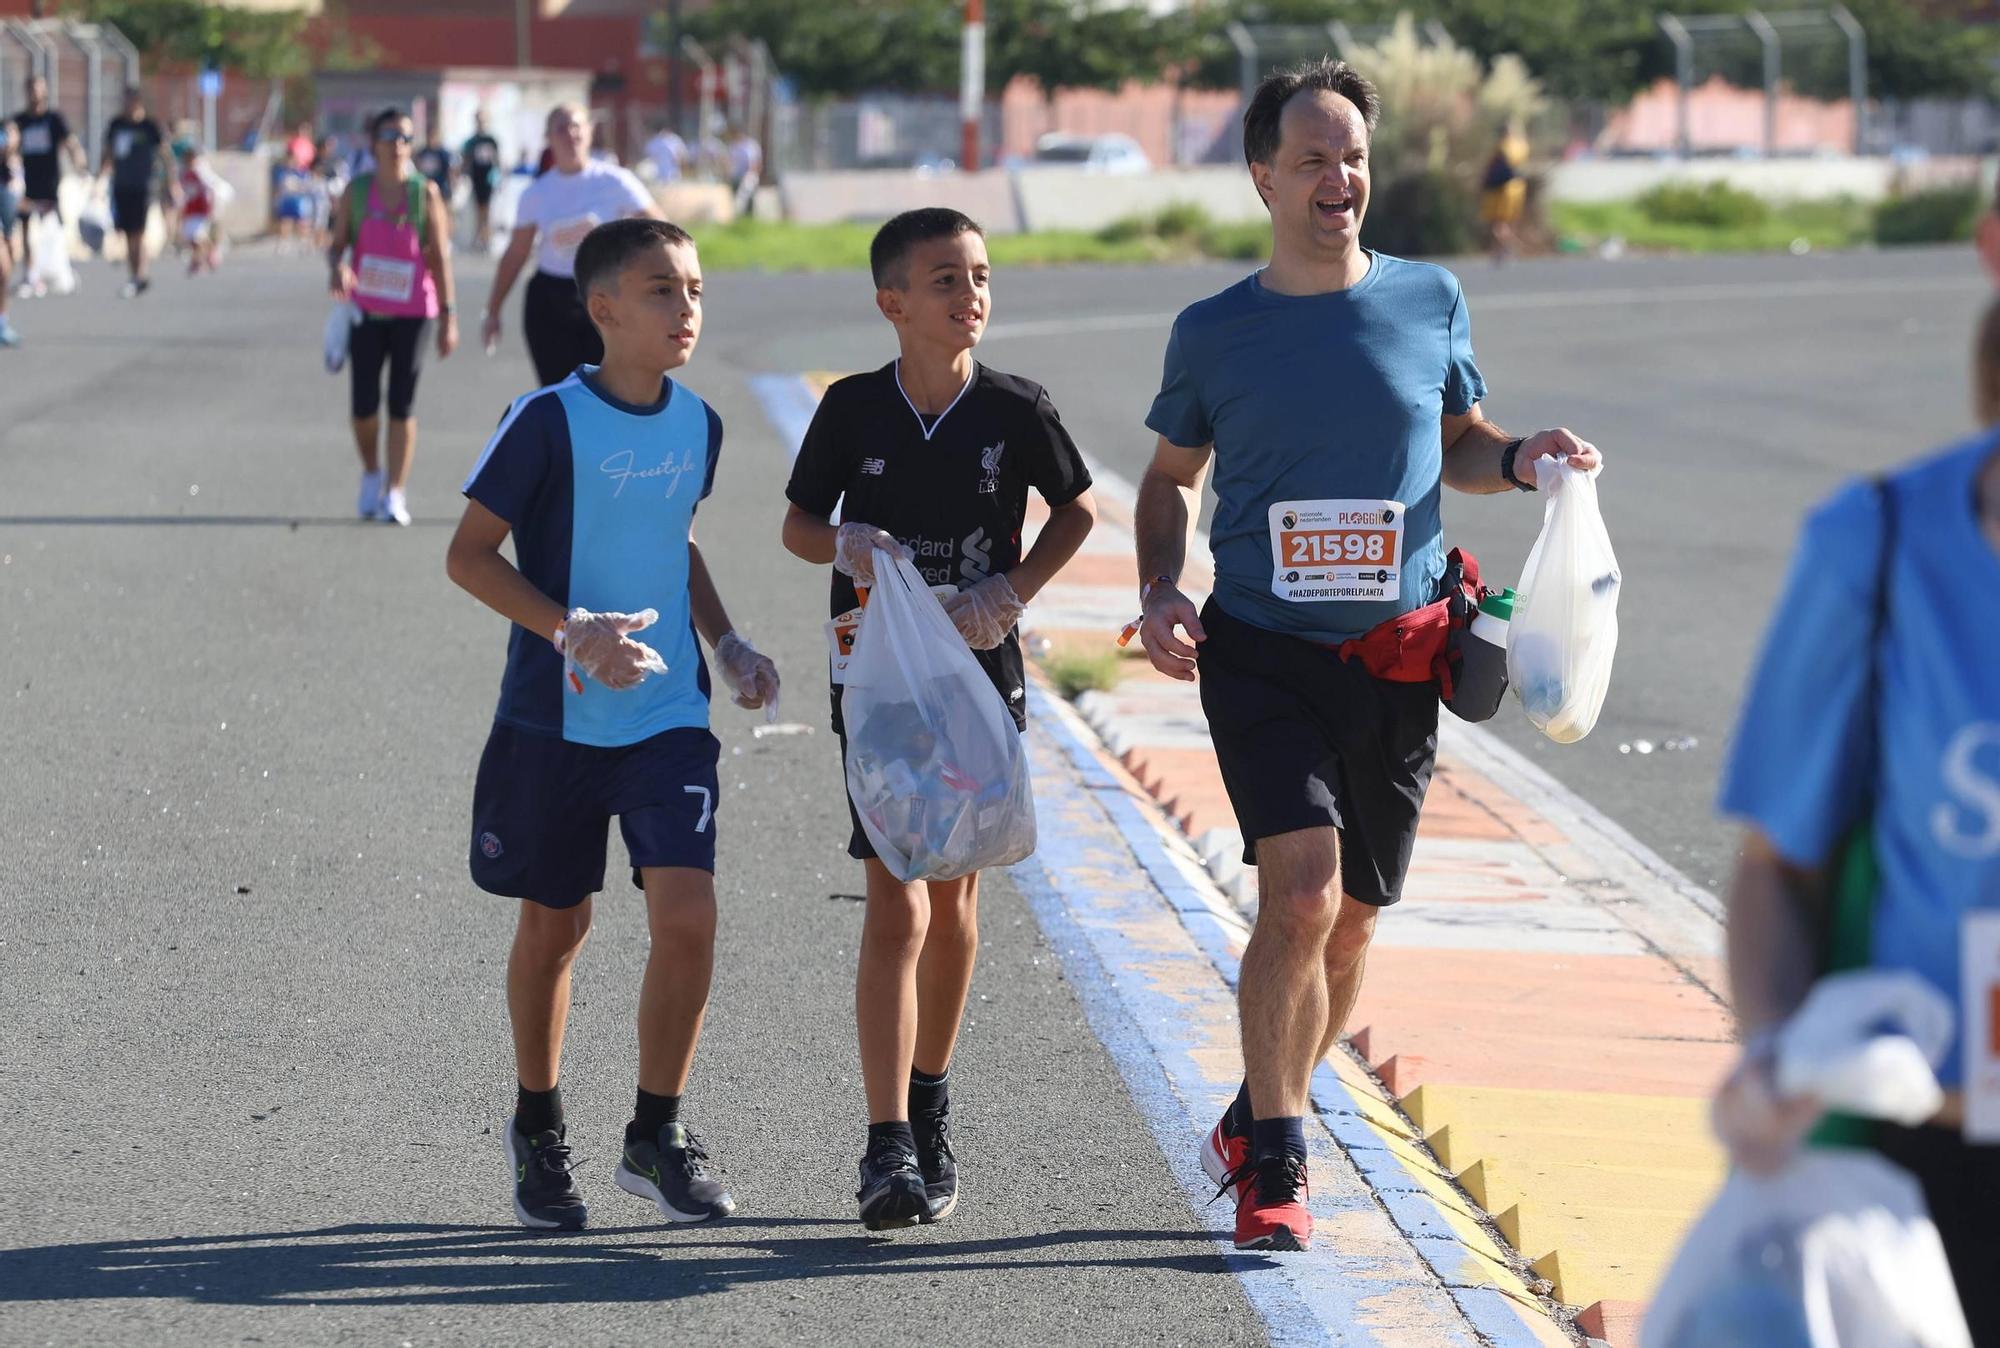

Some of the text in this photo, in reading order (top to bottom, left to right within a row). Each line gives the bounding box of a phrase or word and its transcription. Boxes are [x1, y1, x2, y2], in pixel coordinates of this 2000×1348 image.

[1291, 534, 1384, 562] 21598
[1288, 588, 1384, 598] #HAZDEPORTEPORELPLANETA
[683, 785, 711, 833] 7
